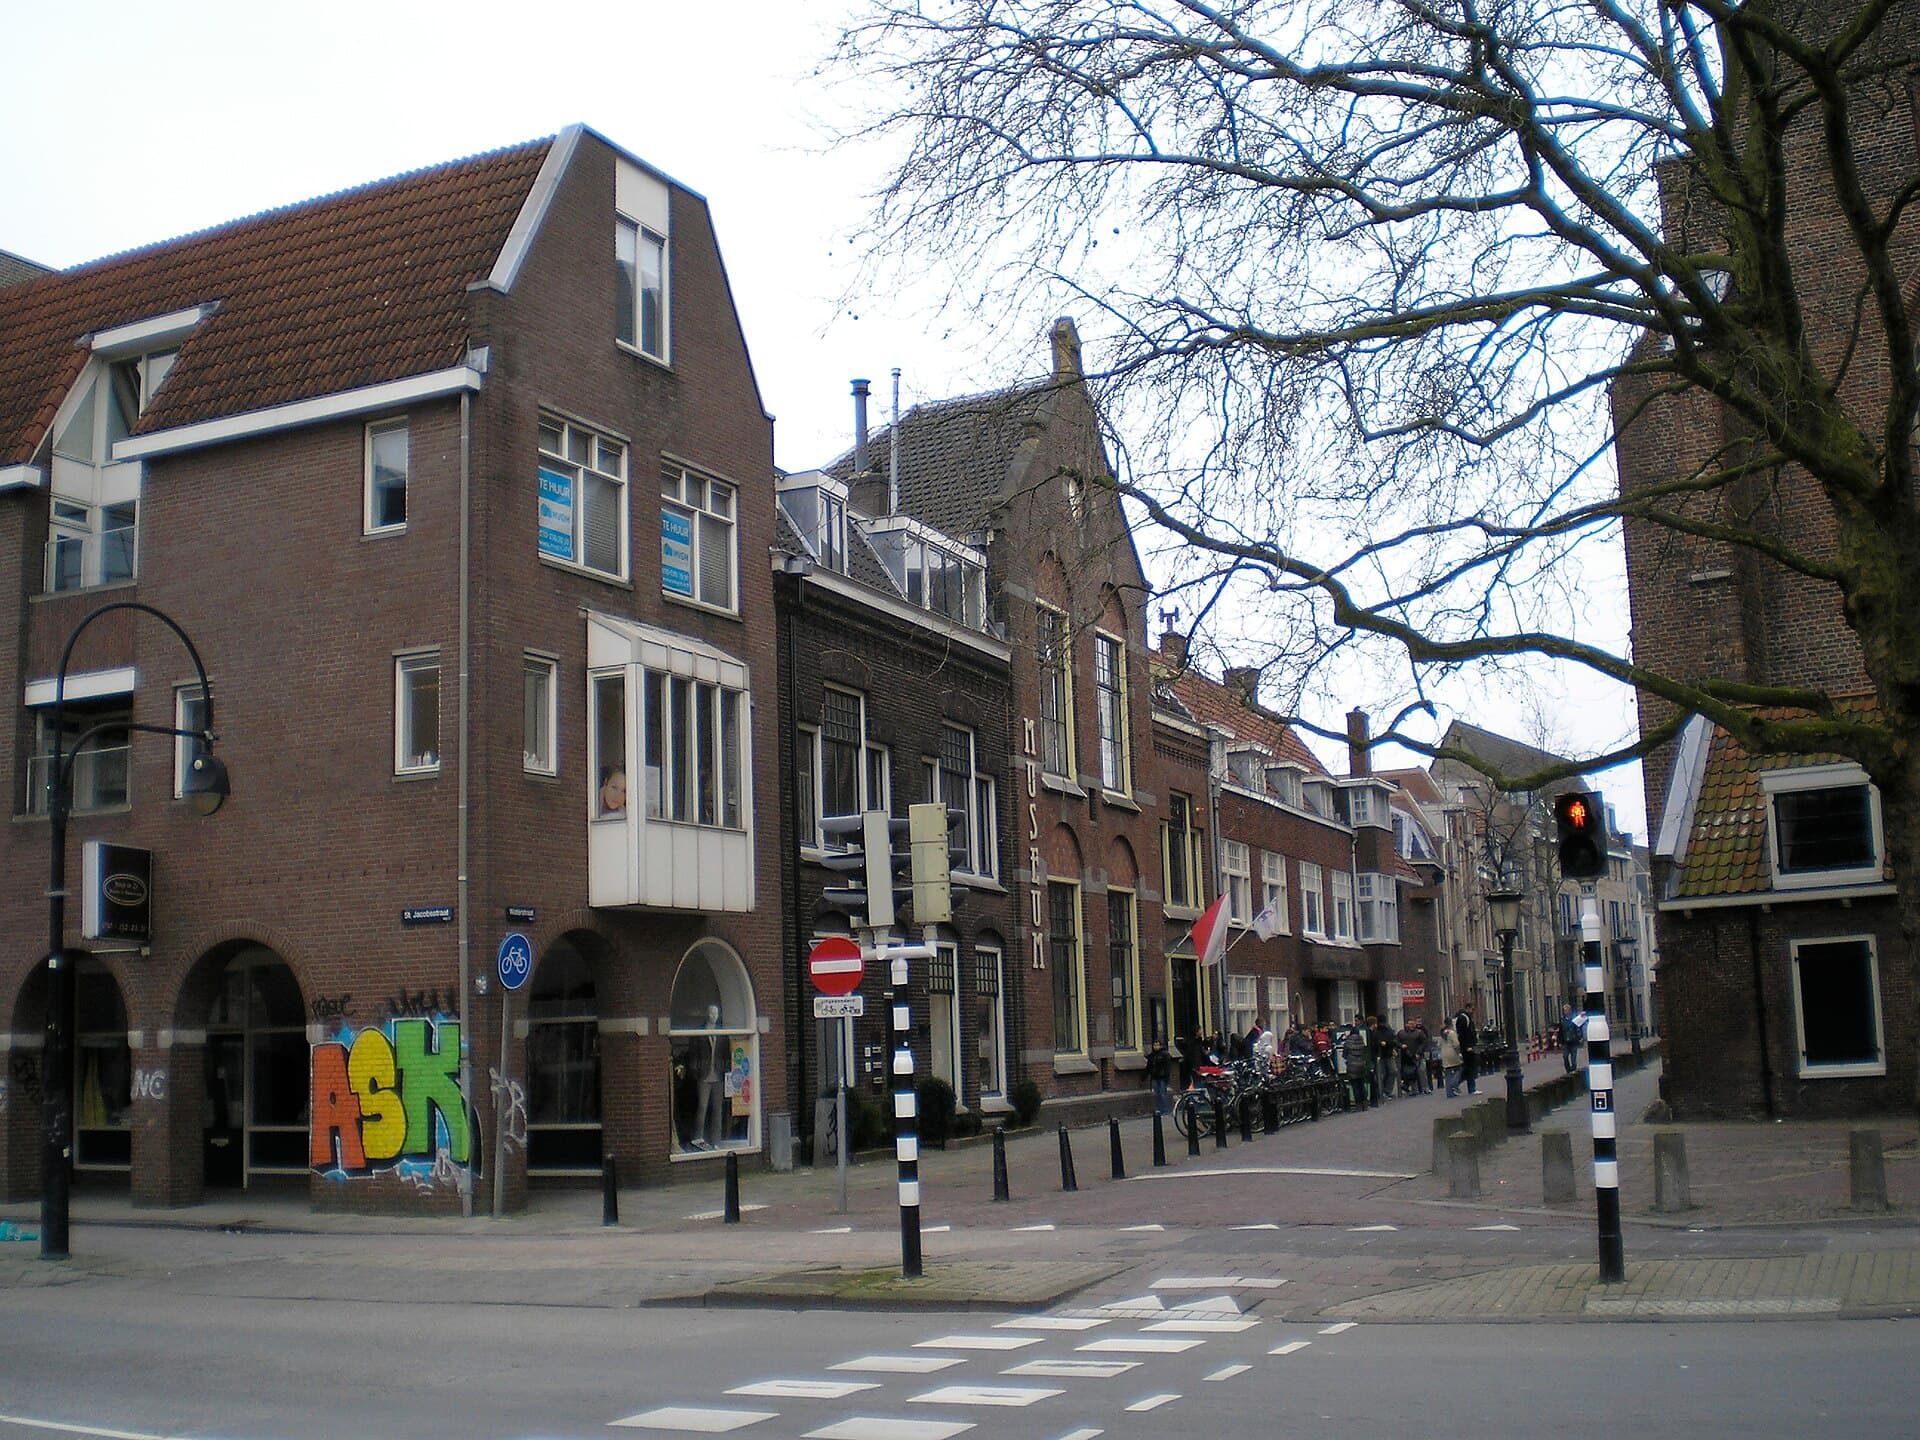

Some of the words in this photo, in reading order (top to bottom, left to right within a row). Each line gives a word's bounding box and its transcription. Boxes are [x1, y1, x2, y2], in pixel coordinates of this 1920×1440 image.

[539, 478, 549, 491] TE
[548, 481, 570, 498] HUUR
[662, 519, 670, 532] TE
[670, 522, 689, 538] HUUR
[1023, 717, 1046, 970] MUSEUM
[309, 1018, 471, 1170] ASK
